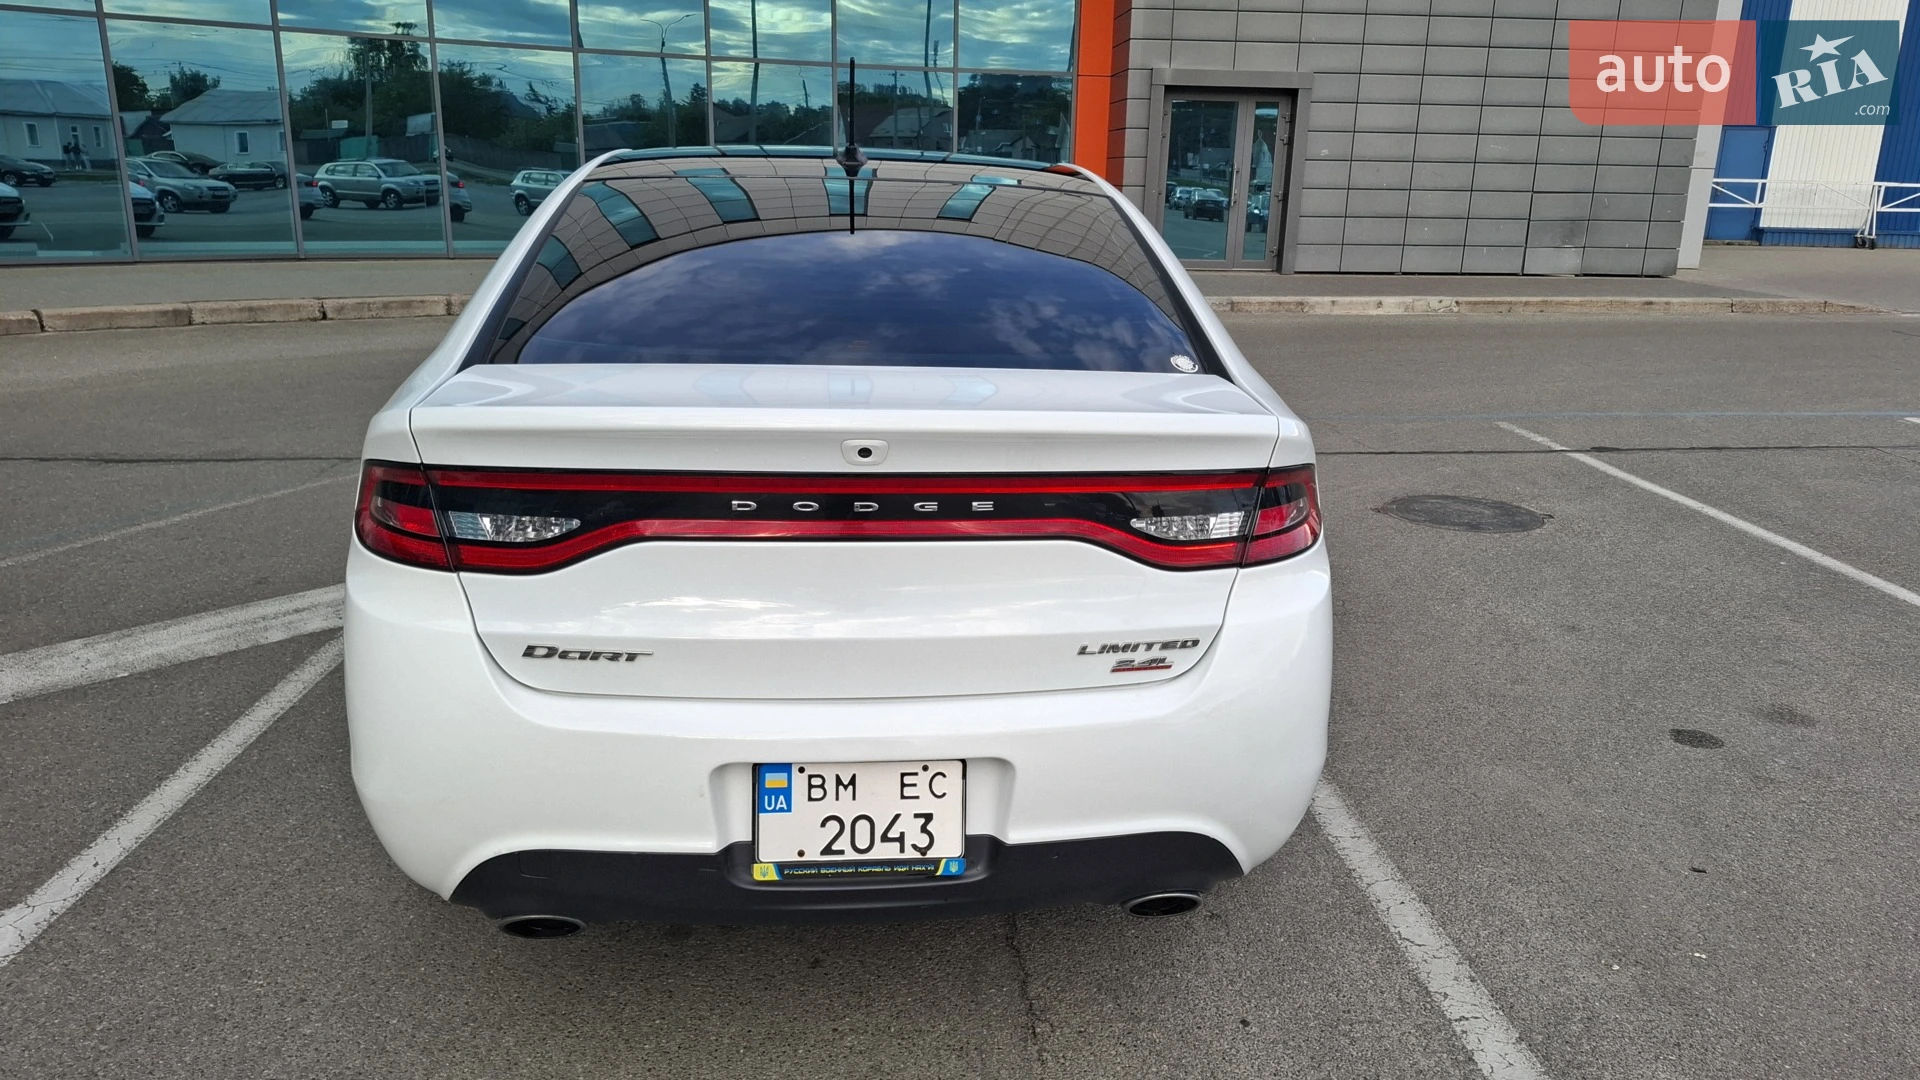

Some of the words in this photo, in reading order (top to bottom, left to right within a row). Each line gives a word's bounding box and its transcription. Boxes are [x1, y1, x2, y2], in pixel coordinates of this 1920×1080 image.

[731, 500, 994, 512] DODGE
[1077, 637, 1200, 655] LIMITED
[1112, 656, 1174, 668] 2.4L
[807, 773, 856, 802] BM
[900, 771, 947, 800] EC
[764, 795, 787, 811] UA
[819, 812, 935, 856] 2043
